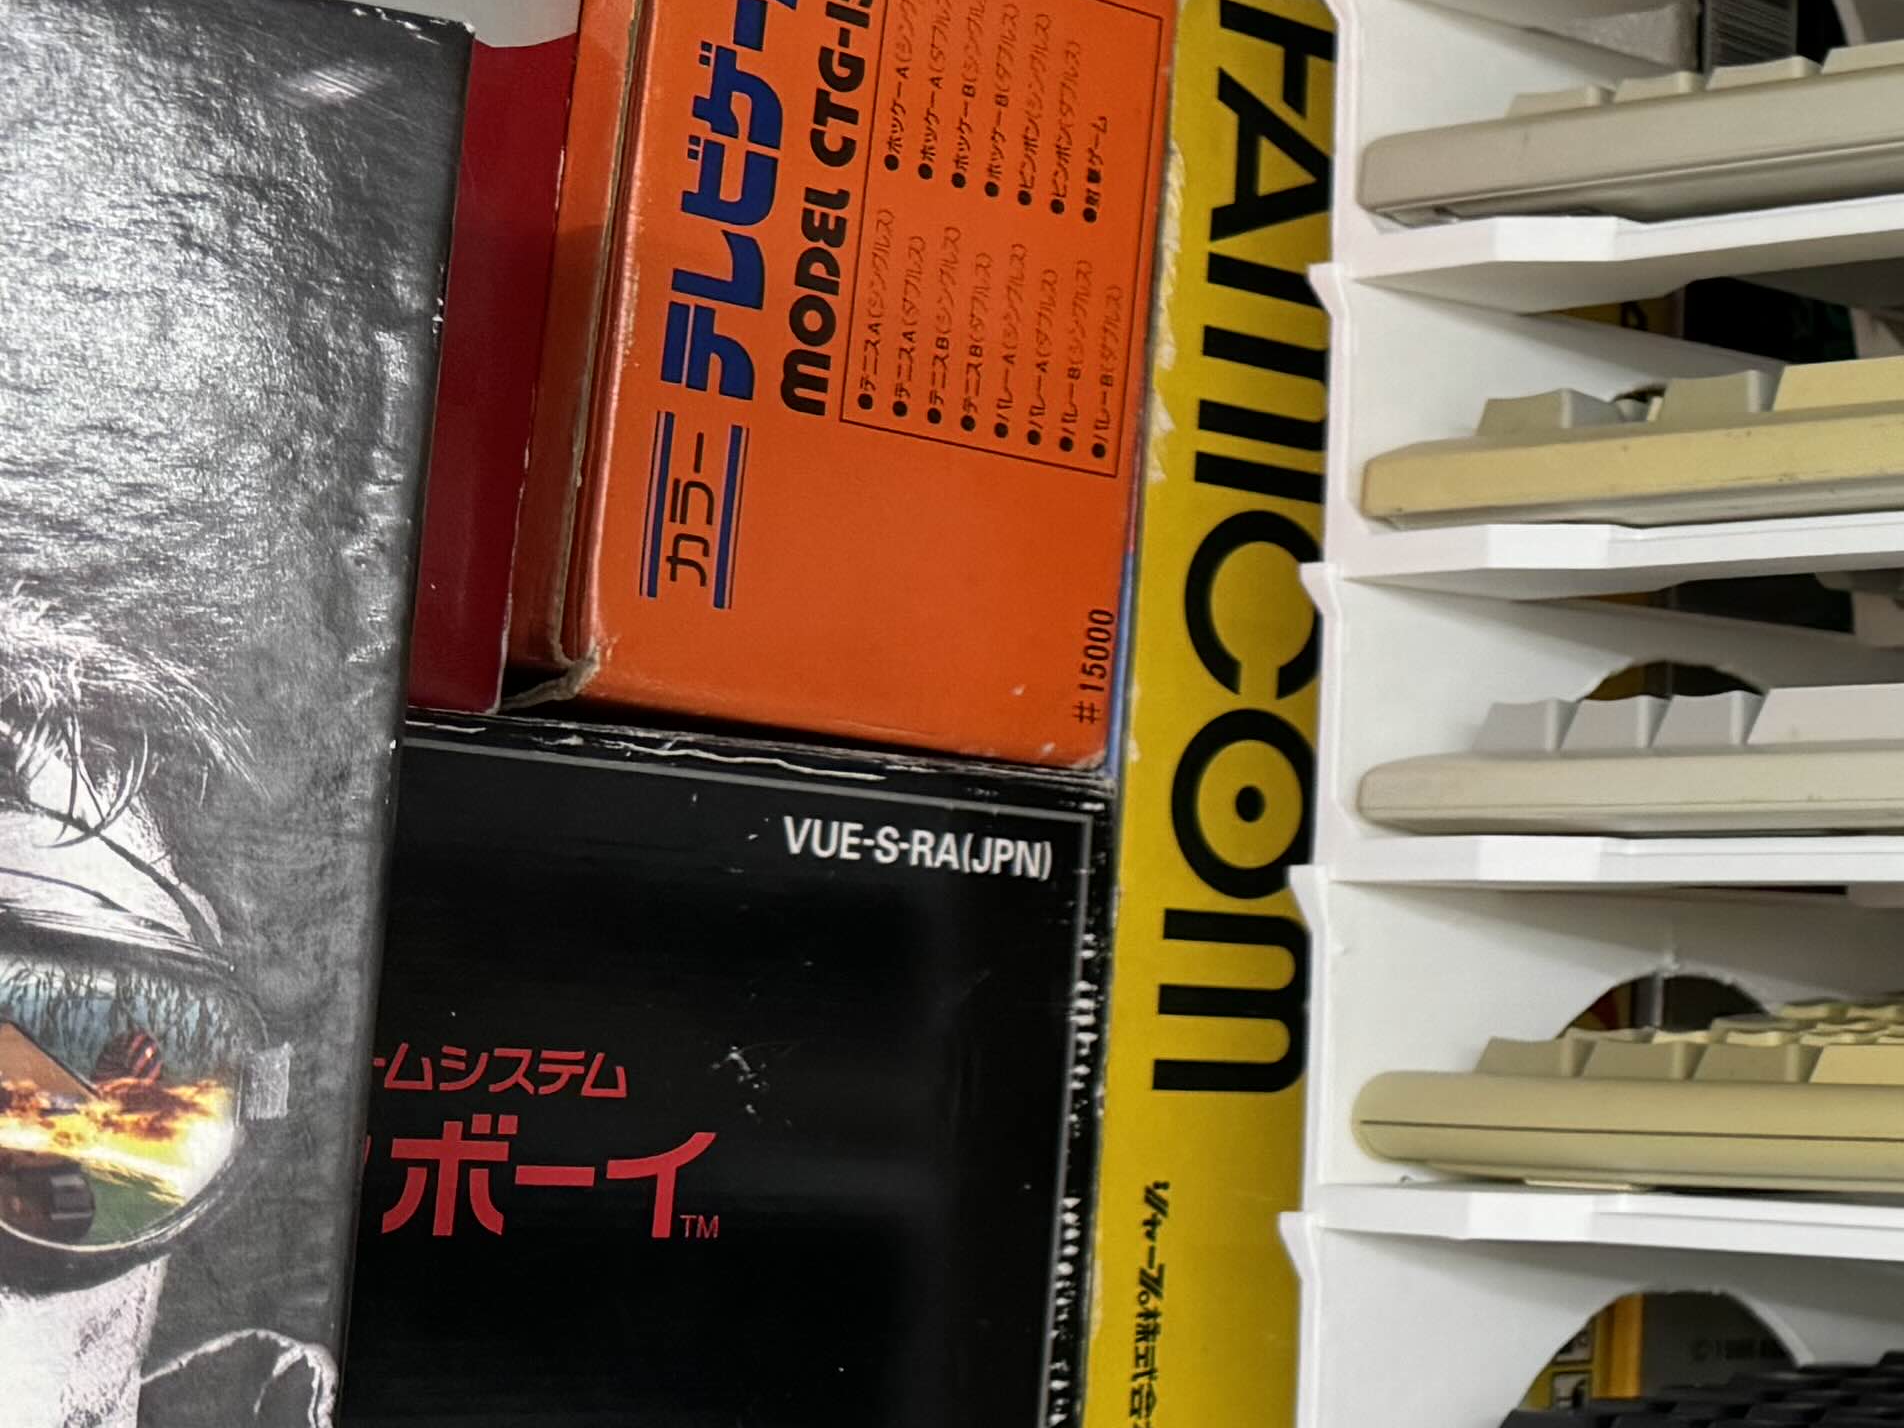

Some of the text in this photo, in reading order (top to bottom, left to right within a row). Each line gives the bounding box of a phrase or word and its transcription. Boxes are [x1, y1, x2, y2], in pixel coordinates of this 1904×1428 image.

[780, 188, 851, 417] MODEL
[666, 431, 714, 586] カラー
[784, 815, 1052, 882] VUE-S-RA(JPN)
[373, 1042, 628, 1098] ムシステム
[363, 1114, 716, 1238] ボーイ
